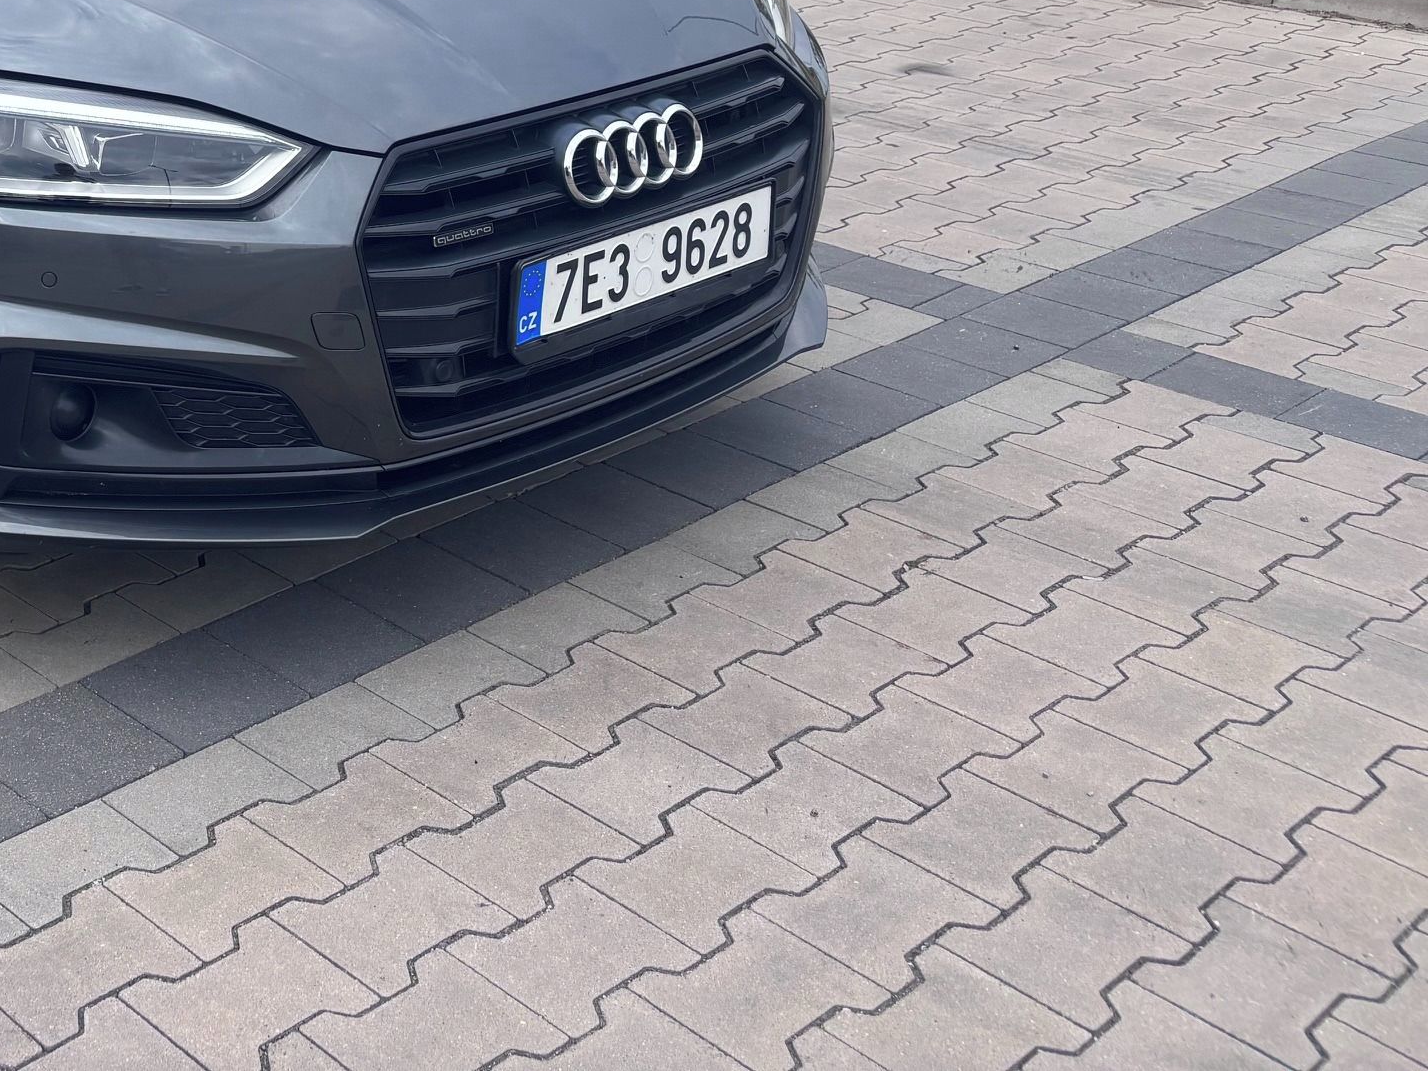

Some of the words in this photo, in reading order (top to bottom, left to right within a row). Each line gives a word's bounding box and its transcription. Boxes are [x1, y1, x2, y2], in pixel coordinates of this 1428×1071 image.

[437, 225, 492, 245] quattro
[553, 243, 631, 324] 7E3
[661, 202, 753, 284] 9628
[519, 312, 538, 333] CZ
